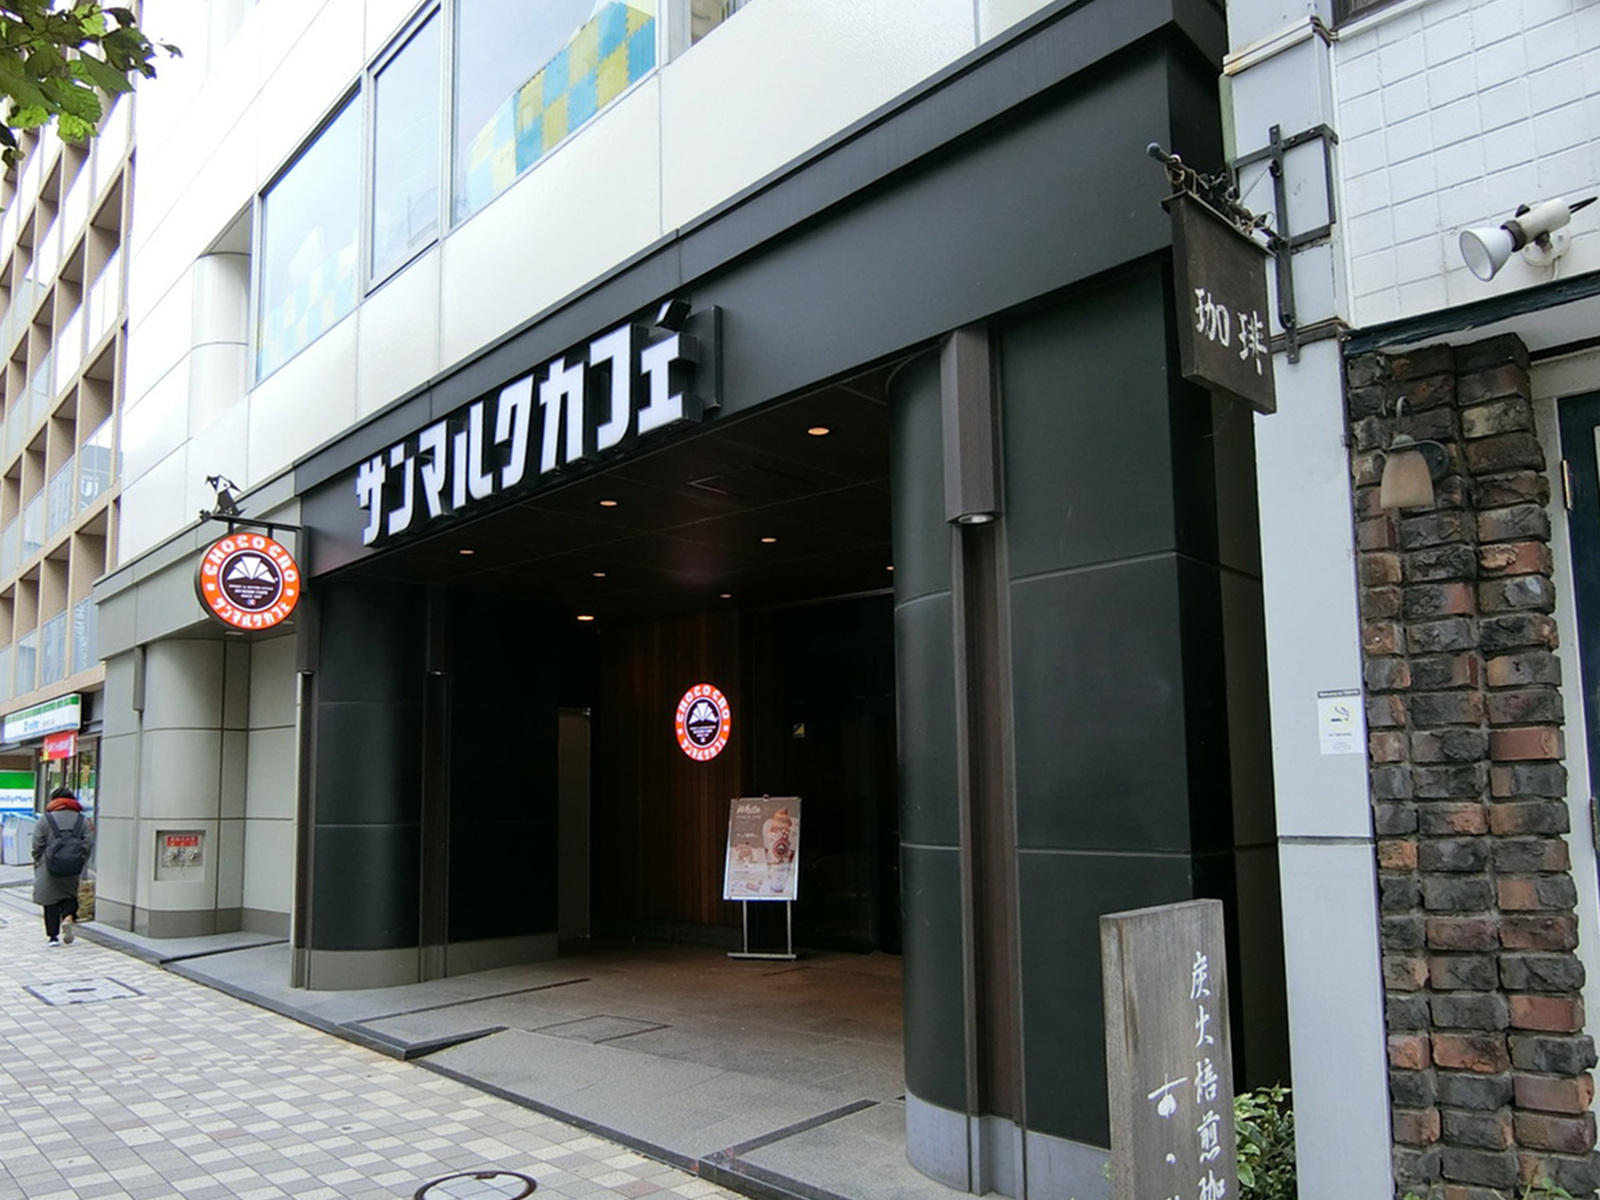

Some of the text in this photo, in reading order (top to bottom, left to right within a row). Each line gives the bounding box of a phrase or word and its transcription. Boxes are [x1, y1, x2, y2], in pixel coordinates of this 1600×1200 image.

[1194, 288, 1268, 376] 珈琲
[355, 299, 685, 546] サンマルクカフェ
